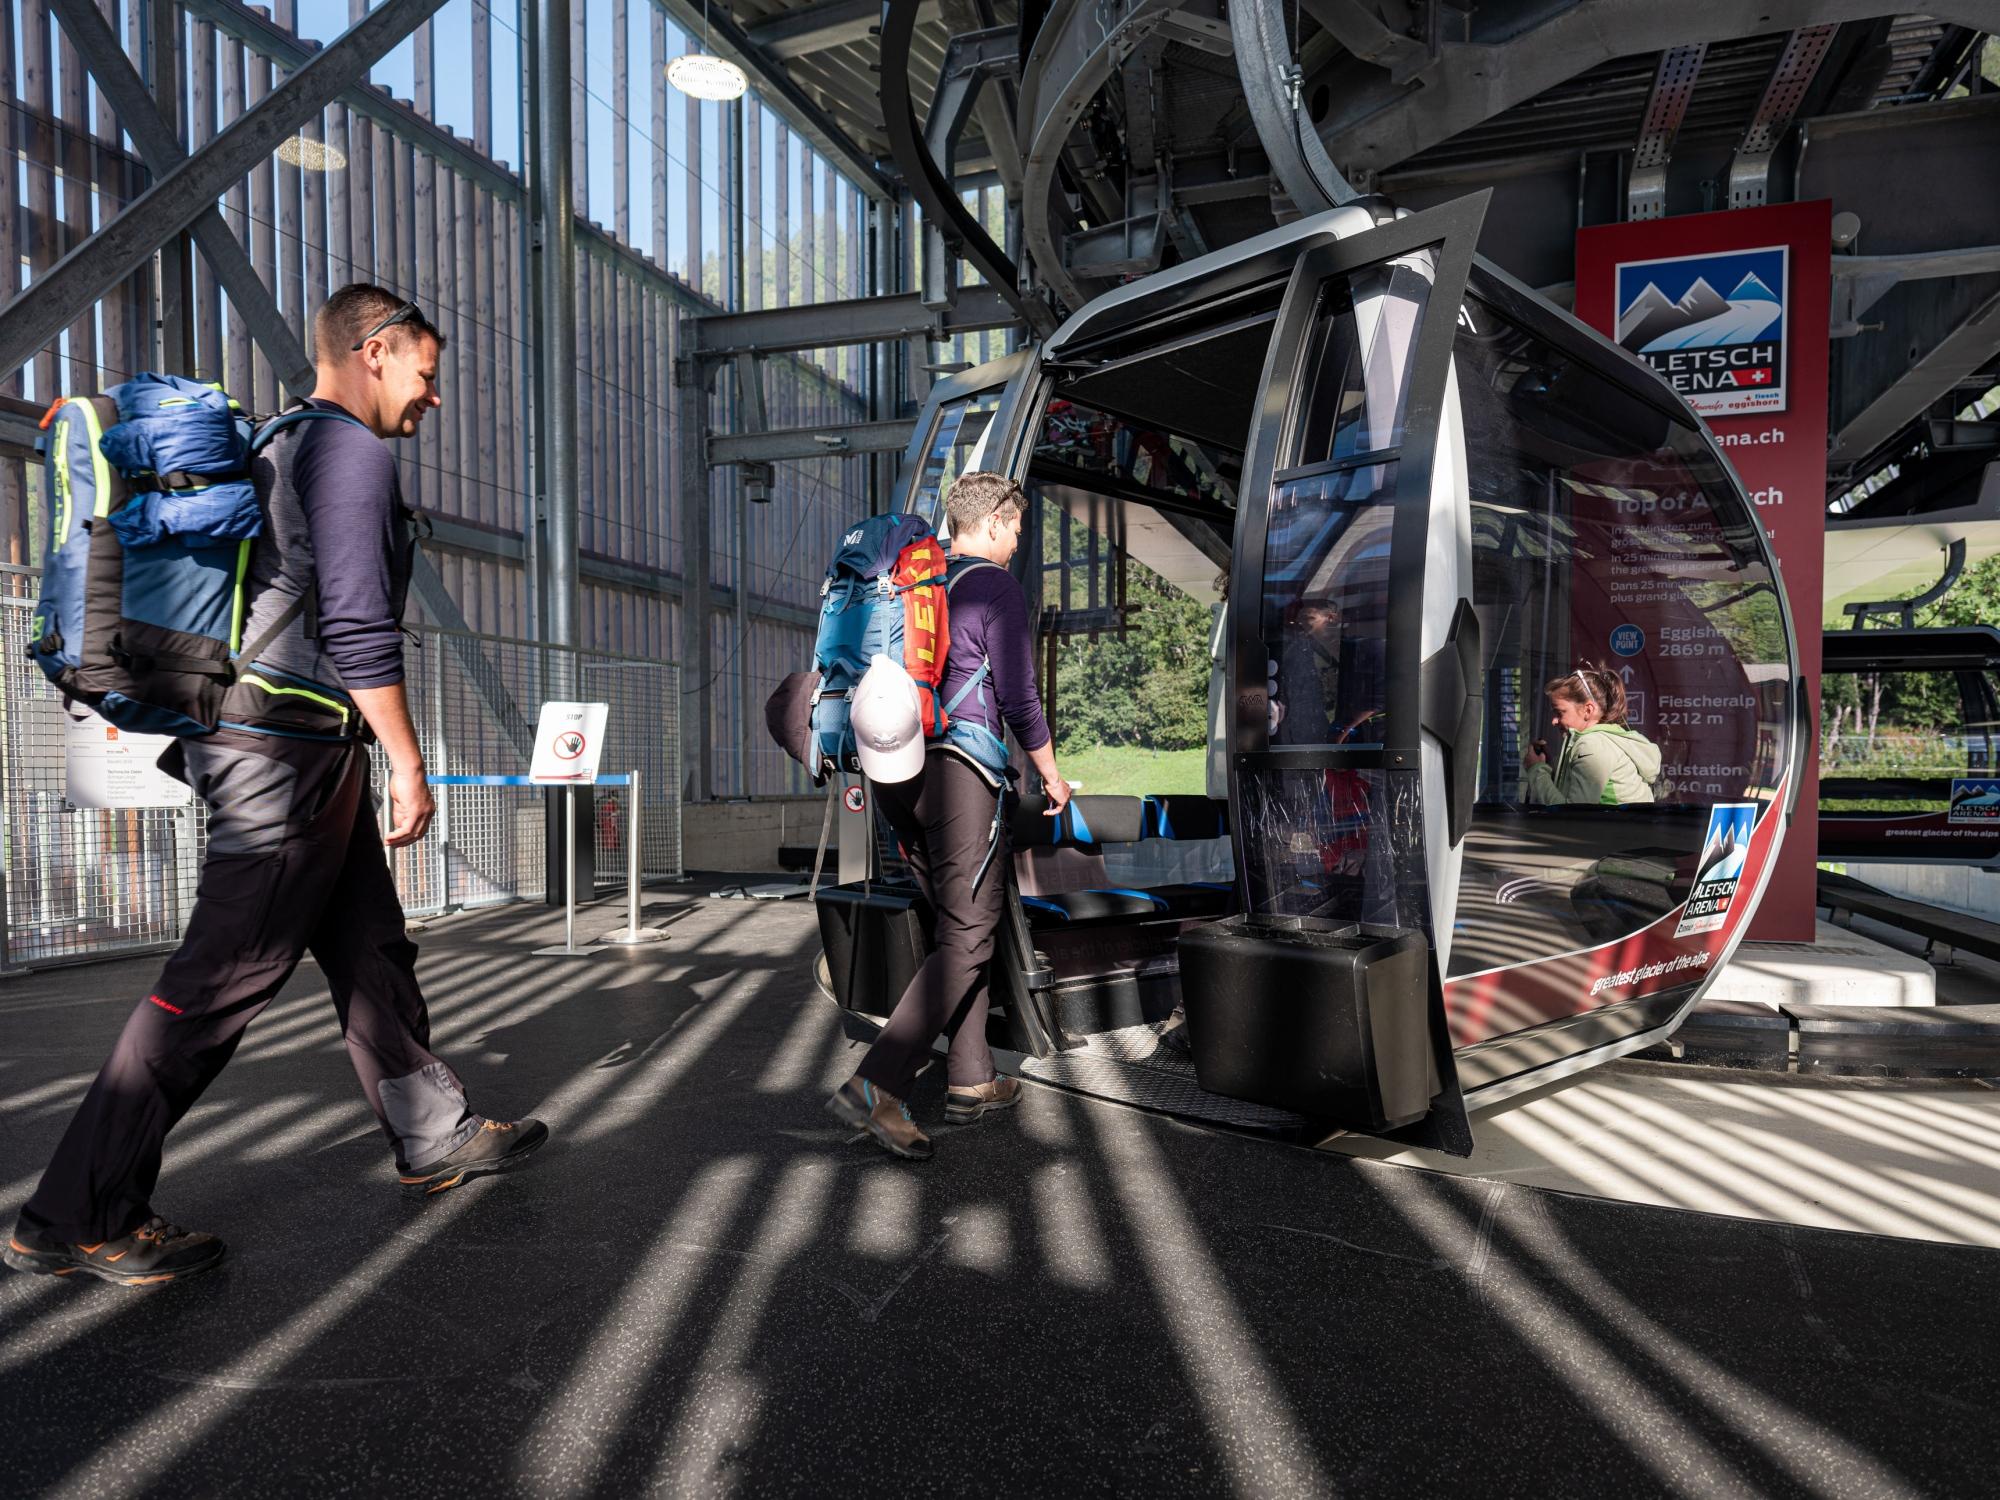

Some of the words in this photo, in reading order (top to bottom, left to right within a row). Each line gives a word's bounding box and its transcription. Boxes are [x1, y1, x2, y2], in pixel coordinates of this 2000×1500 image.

[1637, 346, 1773, 372] LETSCH
[1668, 371, 1739, 391] ENA
[1728, 400, 1780, 410] eggishorn
[1714, 428, 1785, 447] ena.ch
[1615, 497, 1657, 515] Top
[1661, 492, 1687, 511] of
[1688, 521, 1713, 531] zum
[1611, 554, 1622, 563] In
[1623, 553, 1638, 562] 25
[1640, 551, 1686, 561] minutes
[1688, 549, 1699, 559] to
[1611, 565, 1630, 575] the
[1610, 582, 1639, 592] Dans
[1640, 580, 1656, 590] 25
[1610, 593, 1634, 604] plus
[1636, 591, 1668, 603] grand
[911, 549, 936, 664] LEKI
[1617, 631, 1638, 640] VIEW
[1615, 640, 1639, 650] POINT
[1659, 643, 1705, 657] 2869
[1709, 646, 1725, 656] m
[1659, 694, 1757, 710] Fiescheralp
[1658, 712, 1702, 726] 2212
[1707, 713, 1724, 725] m
[1661, 763, 1742, 778] Talstation
[1706, 783, 1723, 794] m
[1953, 803, 1999, 812] ALETSCH
[1885, 829, 1921, 838] greatest
[1922, 829, 1952, 838] glacier
[1953, 829, 1963, 837] of
[1964, 829, 1978, 838] the
[1980, 829, 1999, 839] alps
[1691, 880, 1736, 901] ALETSCH
[1685, 900, 1719, 917] ARENA
[1590, 967, 1637, 996] greatest
[1632, 960, 1667, 985] glacier
[1665, 955, 1679, 973] of
[1676, 954, 1692, 971] the
[1690, 950, 1710, 968] alps
